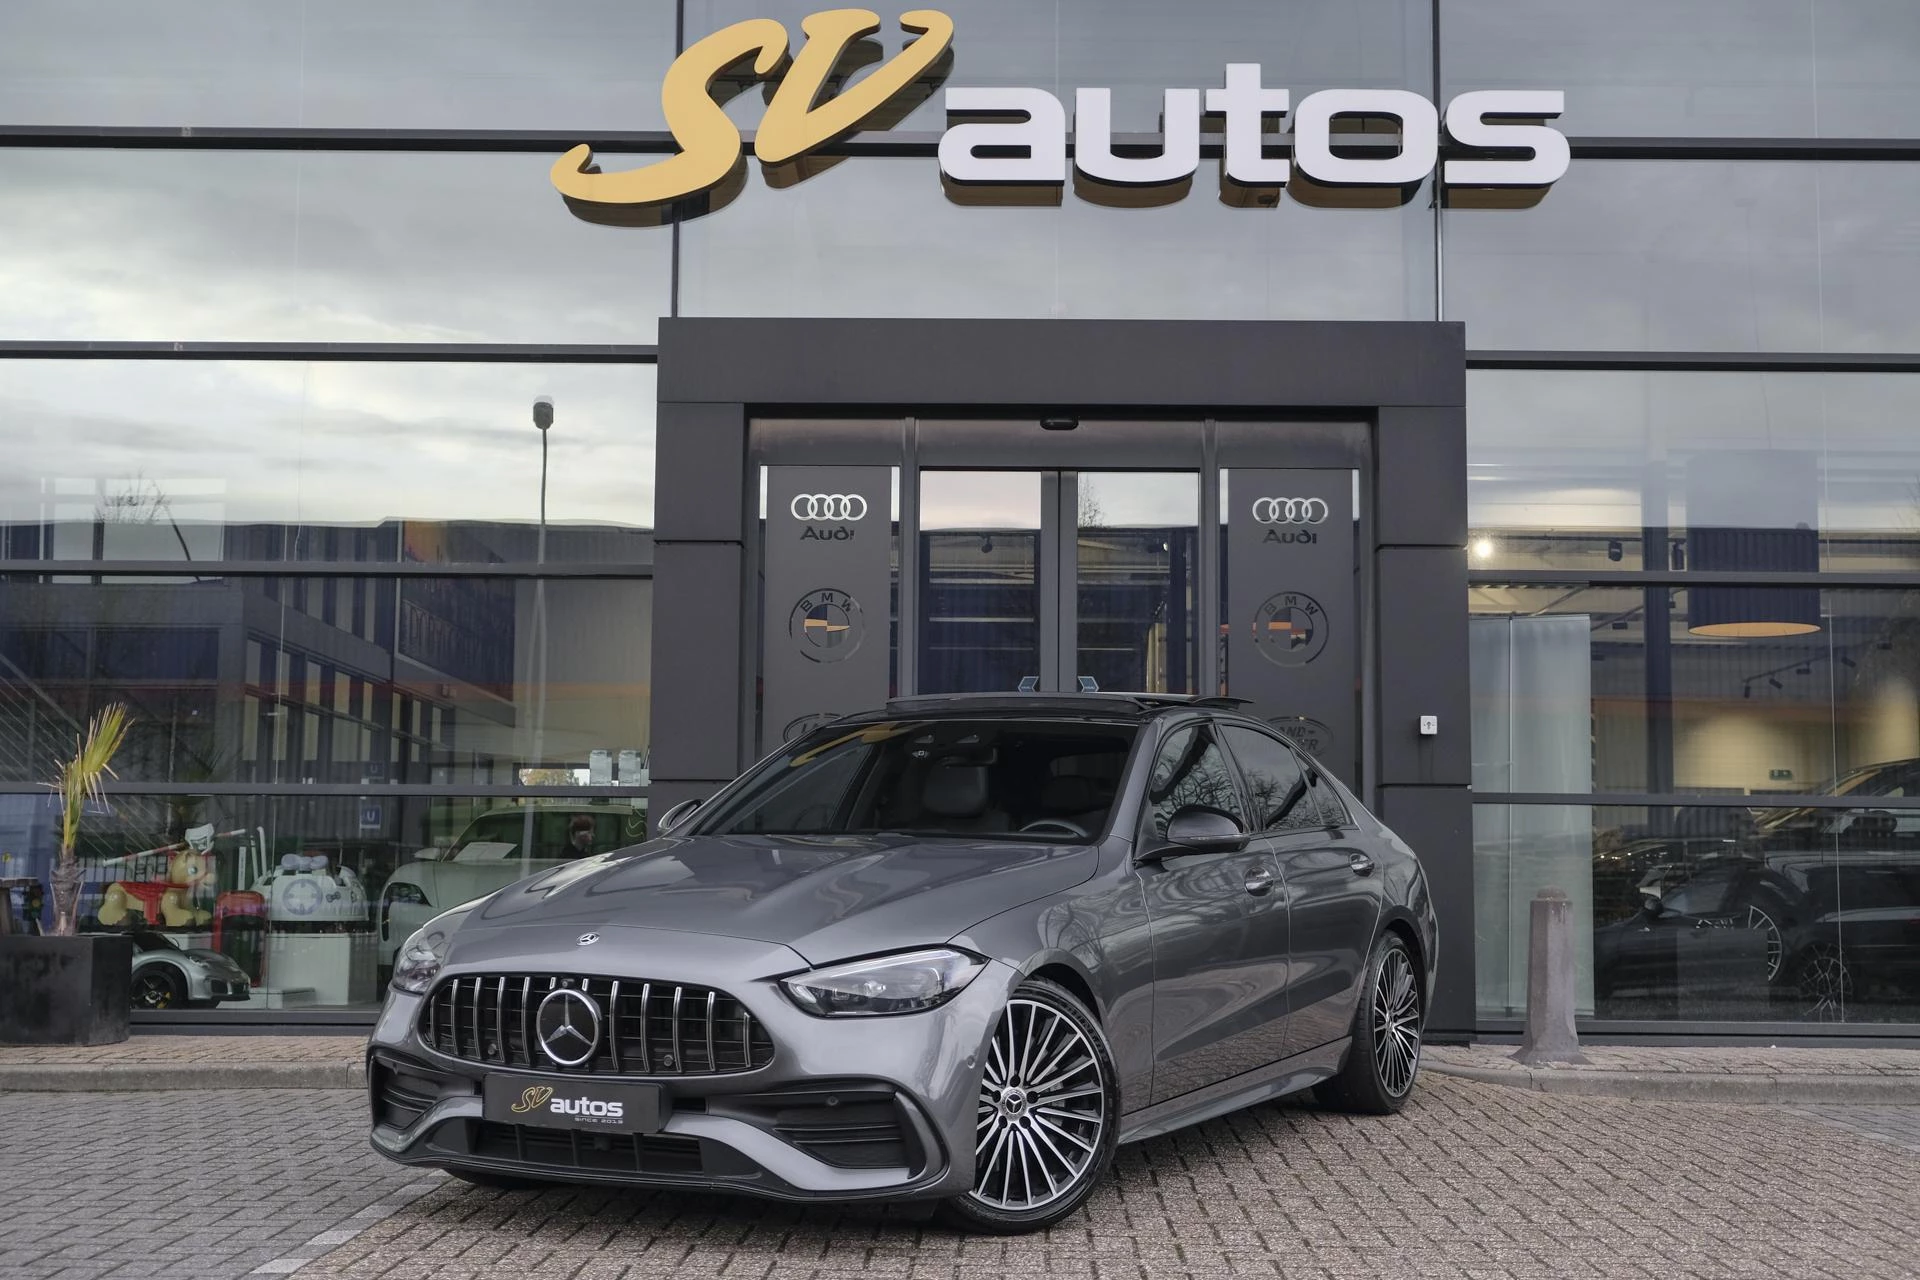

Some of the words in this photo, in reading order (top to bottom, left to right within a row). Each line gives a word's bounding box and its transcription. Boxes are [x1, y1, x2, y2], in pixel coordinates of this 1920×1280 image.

[550, 9, 955, 206] SV
[938, 63, 1571, 188] autos
[800, 526, 855, 540] Audi
[1262, 529, 1317, 544] Audi
[800, 592, 852, 612] BMW
[1264, 595, 1319, 616] BMW
[511, 1086, 553, 1112] SV
[550, 1097, 623, 1117] autos
